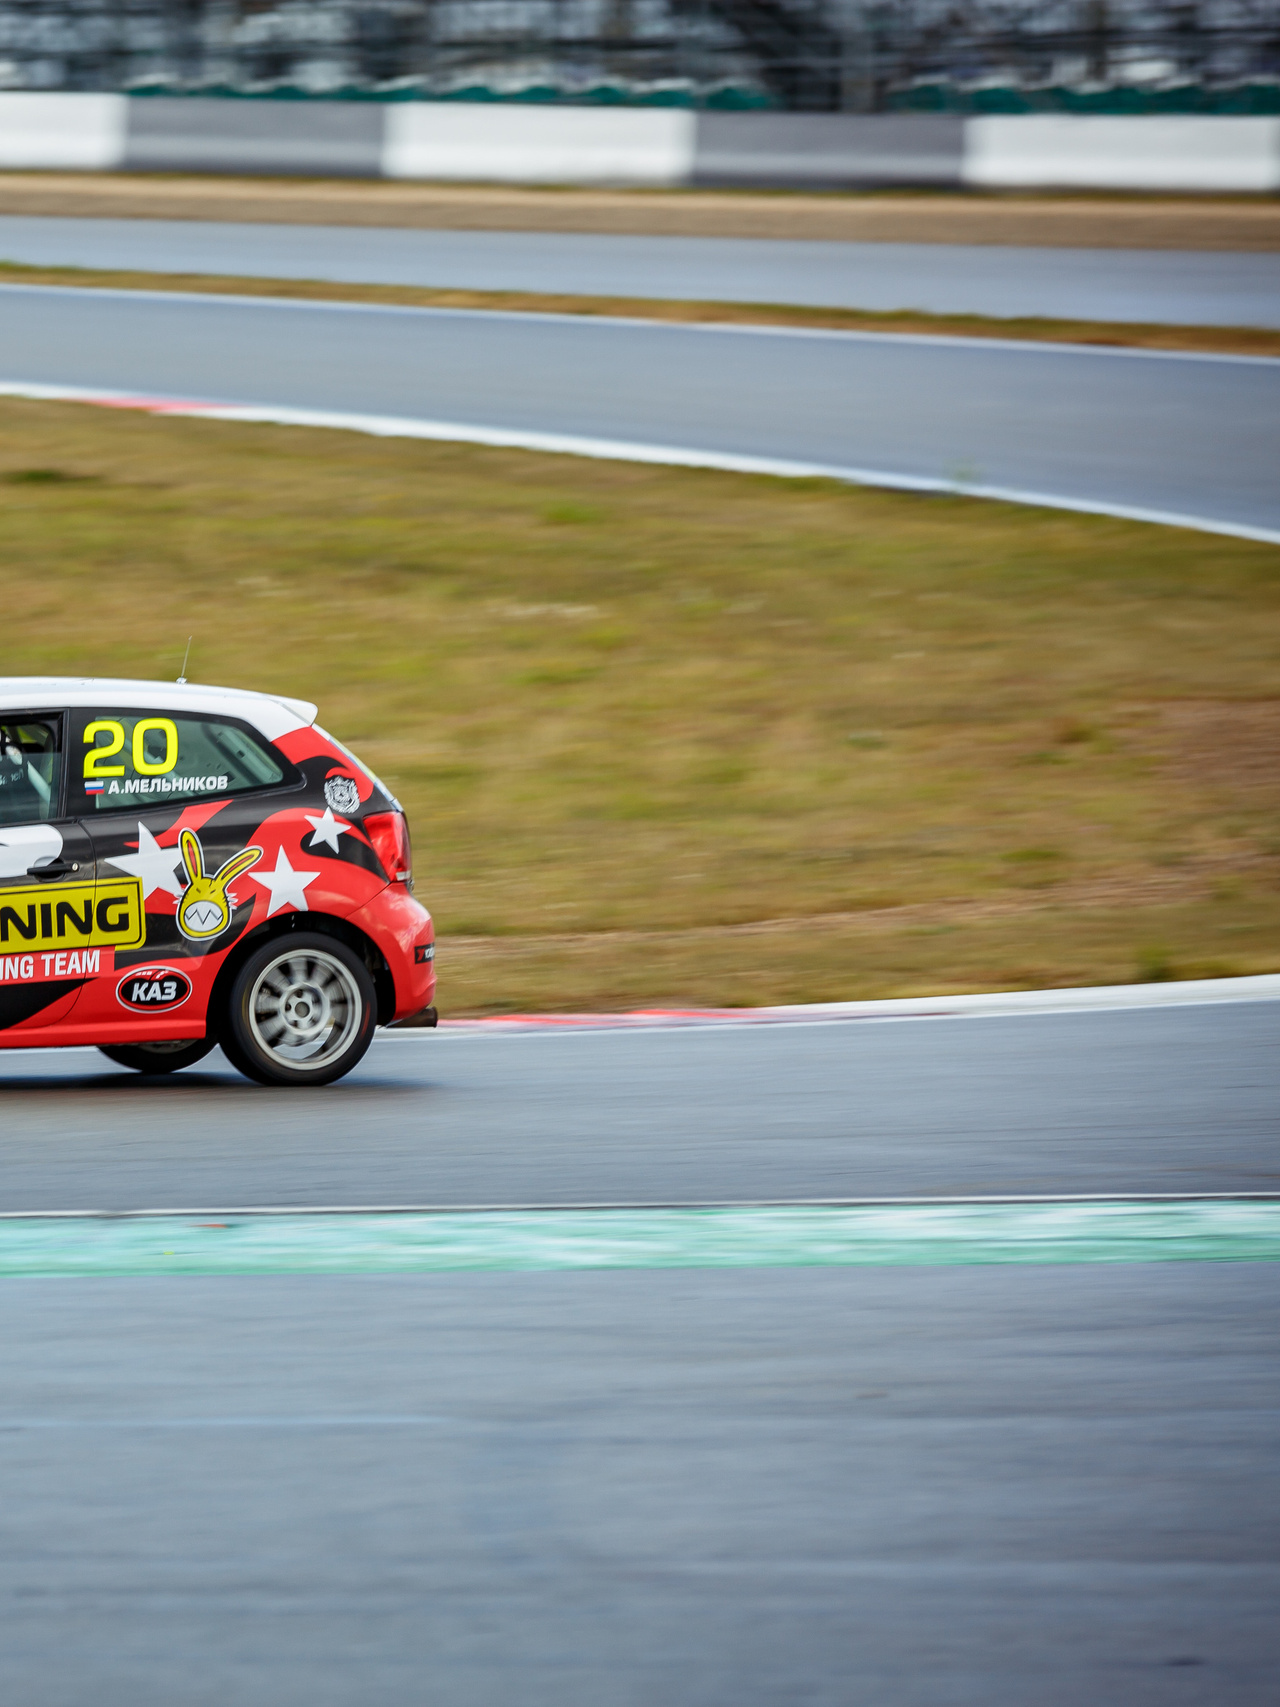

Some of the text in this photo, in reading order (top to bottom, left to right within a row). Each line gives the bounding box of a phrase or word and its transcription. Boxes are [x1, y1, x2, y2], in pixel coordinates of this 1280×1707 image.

[82, 717, 179, 778] 20
[107, 775, 229, 795] А.МЕЛЬНИКОВ
[41, 950, 101, 977] TEAM
